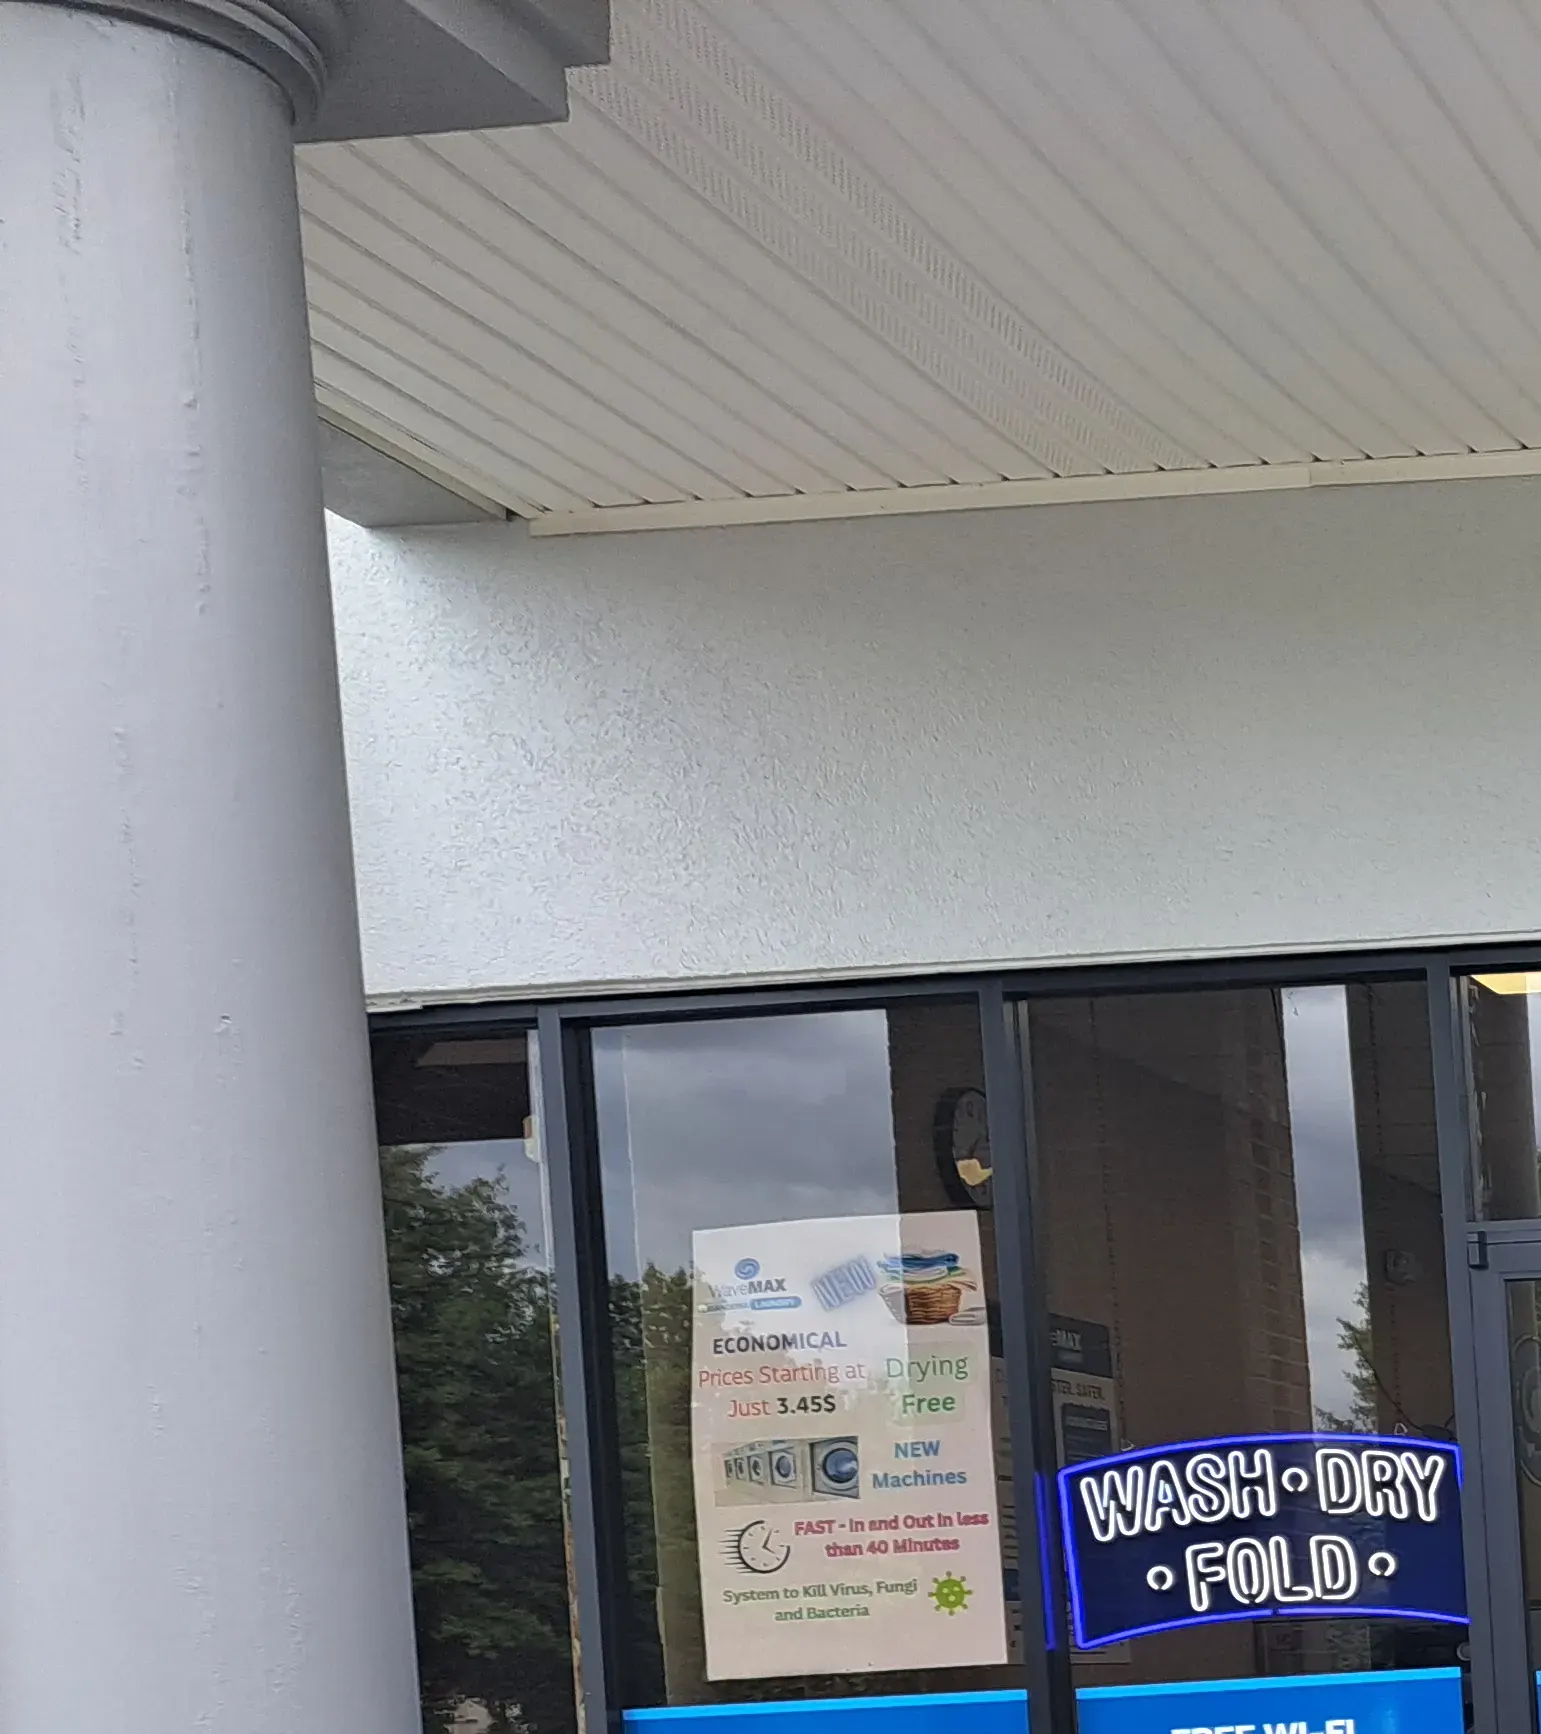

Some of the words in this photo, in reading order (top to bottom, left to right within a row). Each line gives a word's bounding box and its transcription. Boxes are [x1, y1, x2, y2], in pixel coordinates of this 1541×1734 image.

[810, 1255, 877, 1312] NEW
[712, 1330, 848, 1355] ECONOMICAL
[699, 1368, 754, 1388] Prices
[759, 1361, 840, 1384] Starting
[845, 1363, 867, 1380] at
[886, 1354, 969, 1382] Drying
[727, 1399, 770, 1418] Just
[776, 1394, 837, 1415] 3.45$
[901, 1394, 957, 1414] Free
[894, 1440, 941, 1459] NEW
[872, 1469, 968, 1490] Machines
[1080, 1448, 1275, 1542] WASH
[1315, 1447, 1446, 1522] DRY
[794, 1519, 837, 1536] FAST
[868, 1515, 899, 1532] and
[903, 1513, 934, 1530] Out
[956, 1510, 990, 1526] less
[825, 1542, 863, 1558] than
[866, 1540, 889, 1555] 40
[892, 1536, 961, 1554] Minutes
[1185, 1534, 1359, 1612] FOLD
[723, 1587, 780, 1606] System
[783, 1586, 799, 1599] to
[802, 1582, 828, 1598] Kill
[831, 1581, 874, 1598] Virus,
[876, 1578, 918, 1596] Fungi
[774, 1607, 803, 1622] and
[806, 1603, 871, 1620] Bacteria
